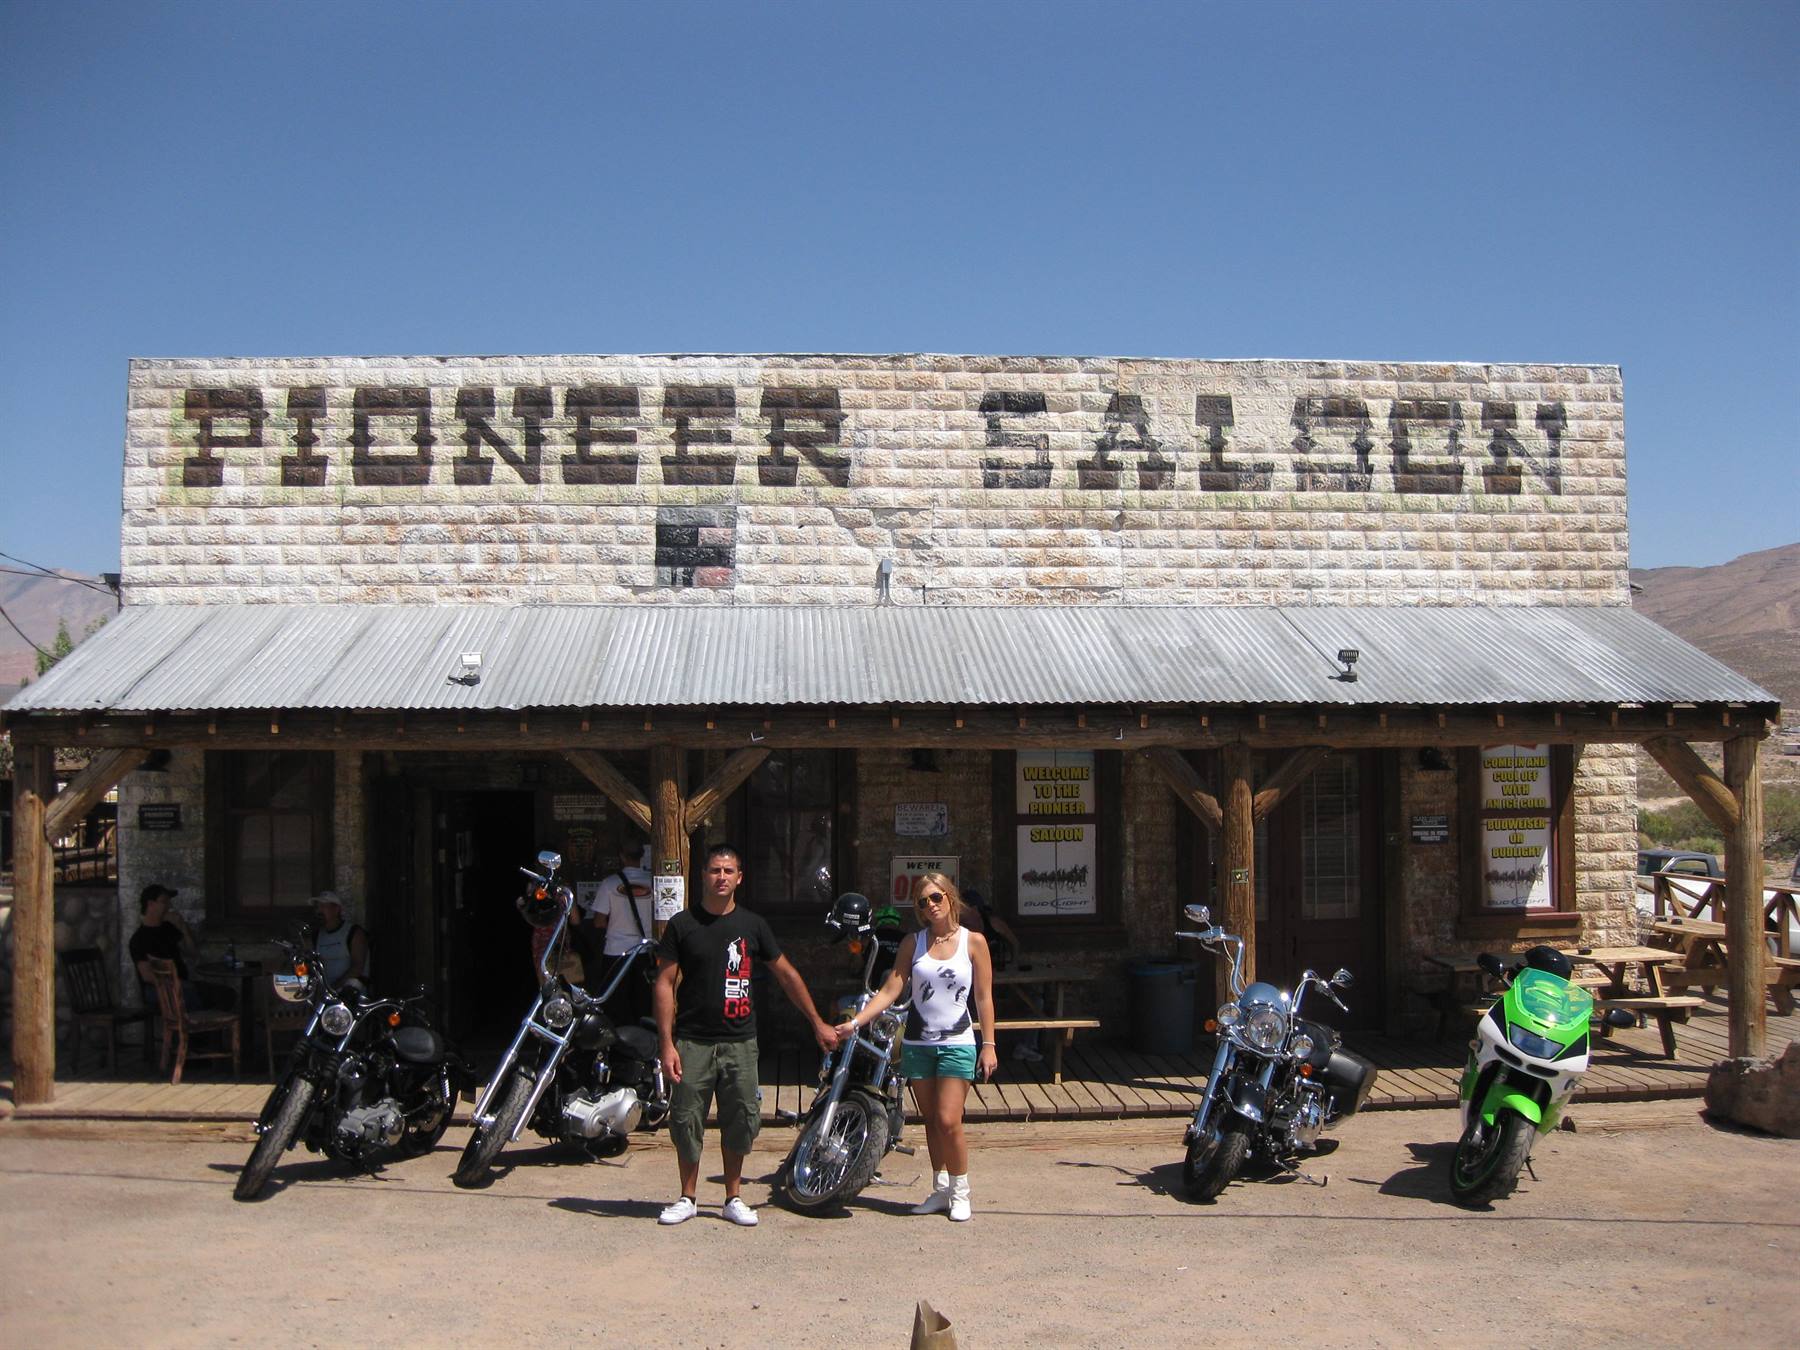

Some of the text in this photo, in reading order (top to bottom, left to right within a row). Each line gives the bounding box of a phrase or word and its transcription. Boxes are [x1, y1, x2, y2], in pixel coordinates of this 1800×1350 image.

[183, 386, 1567, 496] PIONEER SALOON
[1484, 757, 1547, 768] COME IN AND
[1023, 767, 1090, 781] WELCOME
[1493, 771, 1539, 782] COOL OFF
[1034, 784, 1081, 798] TO THE
[1502, 785, 1530, 796] WITH
[1029, 802, 1086, 816] PIONEER
[1486, 799, 1546, 809] AN ICE COLD
[1487, 818, 1546, 831] BUDWEISER
[1030, 827, 1084, 842] SALOON
[1509, 833, 1524, 844] OR
[906, 861, 943, 870] WE'RE
